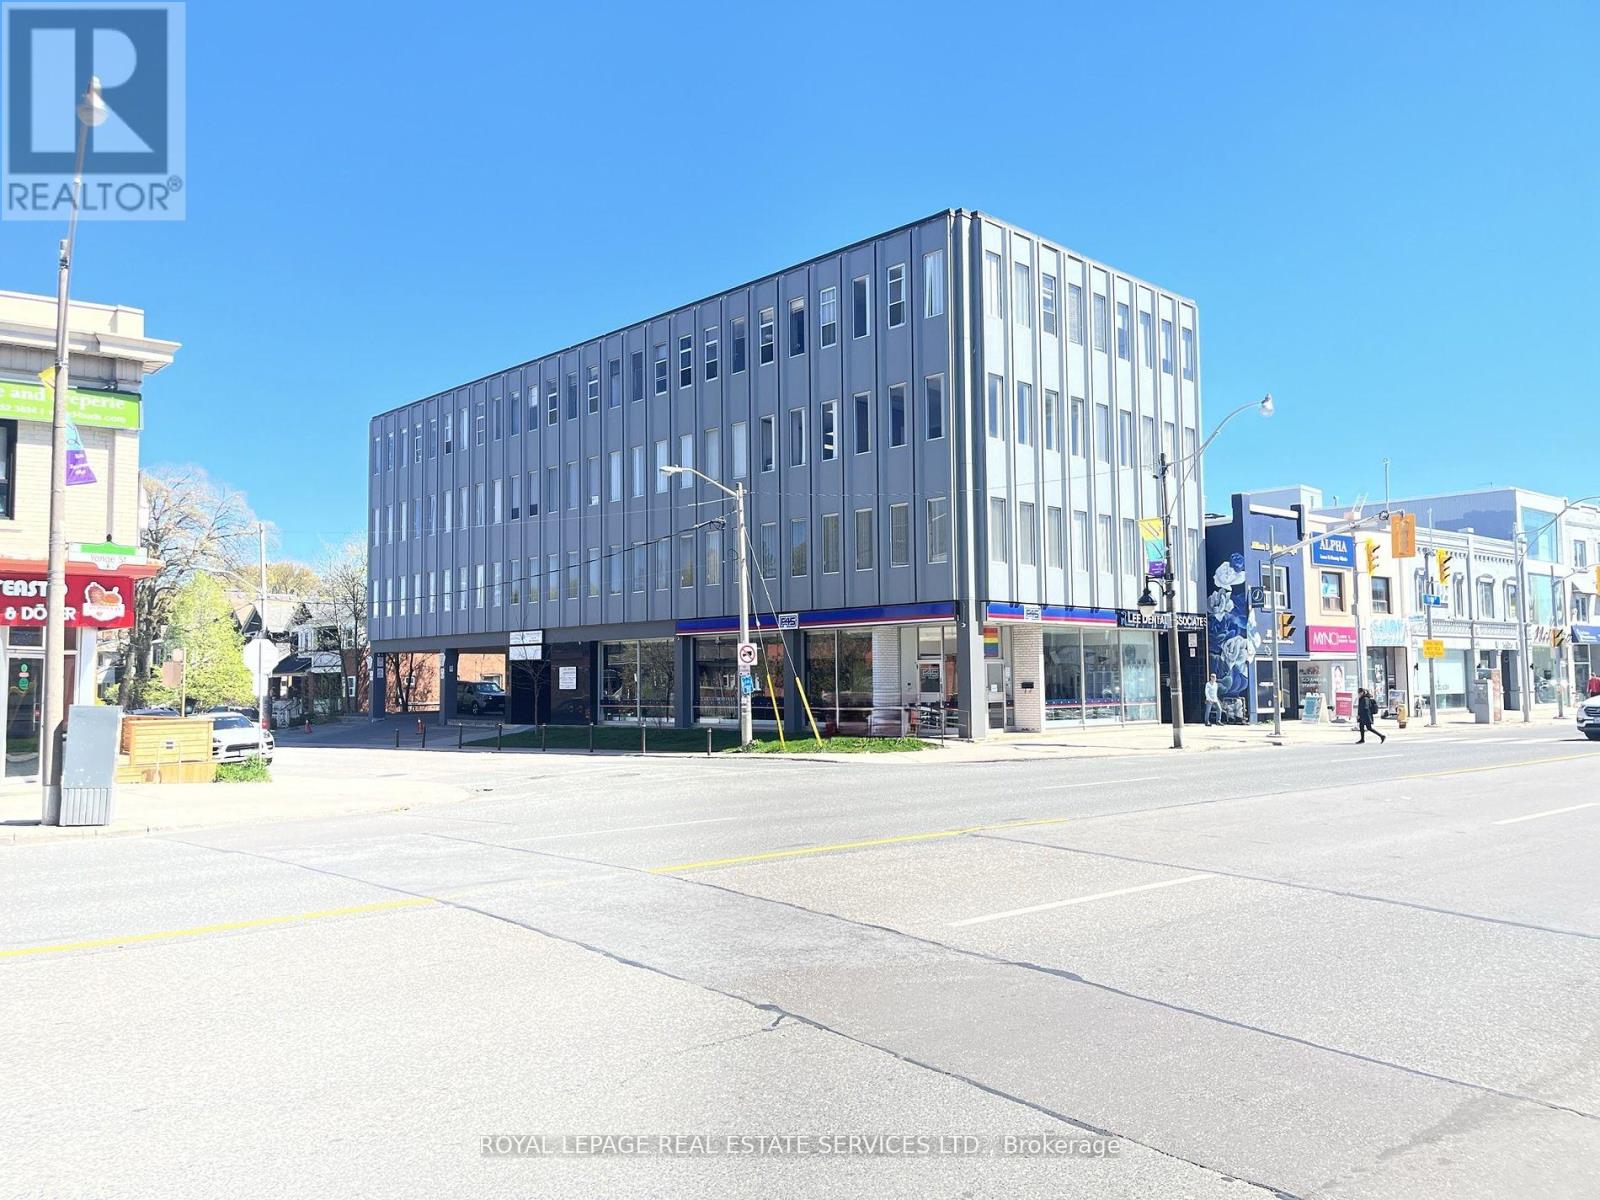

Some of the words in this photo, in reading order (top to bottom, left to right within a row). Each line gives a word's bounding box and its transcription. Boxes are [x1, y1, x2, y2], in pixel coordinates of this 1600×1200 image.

[10, 387, 46, 401] and
[1319, 538, 1348, 553] ALPHA
[4, 606, 17, 621] &
[1127, 610, 1141, 625] LEE
